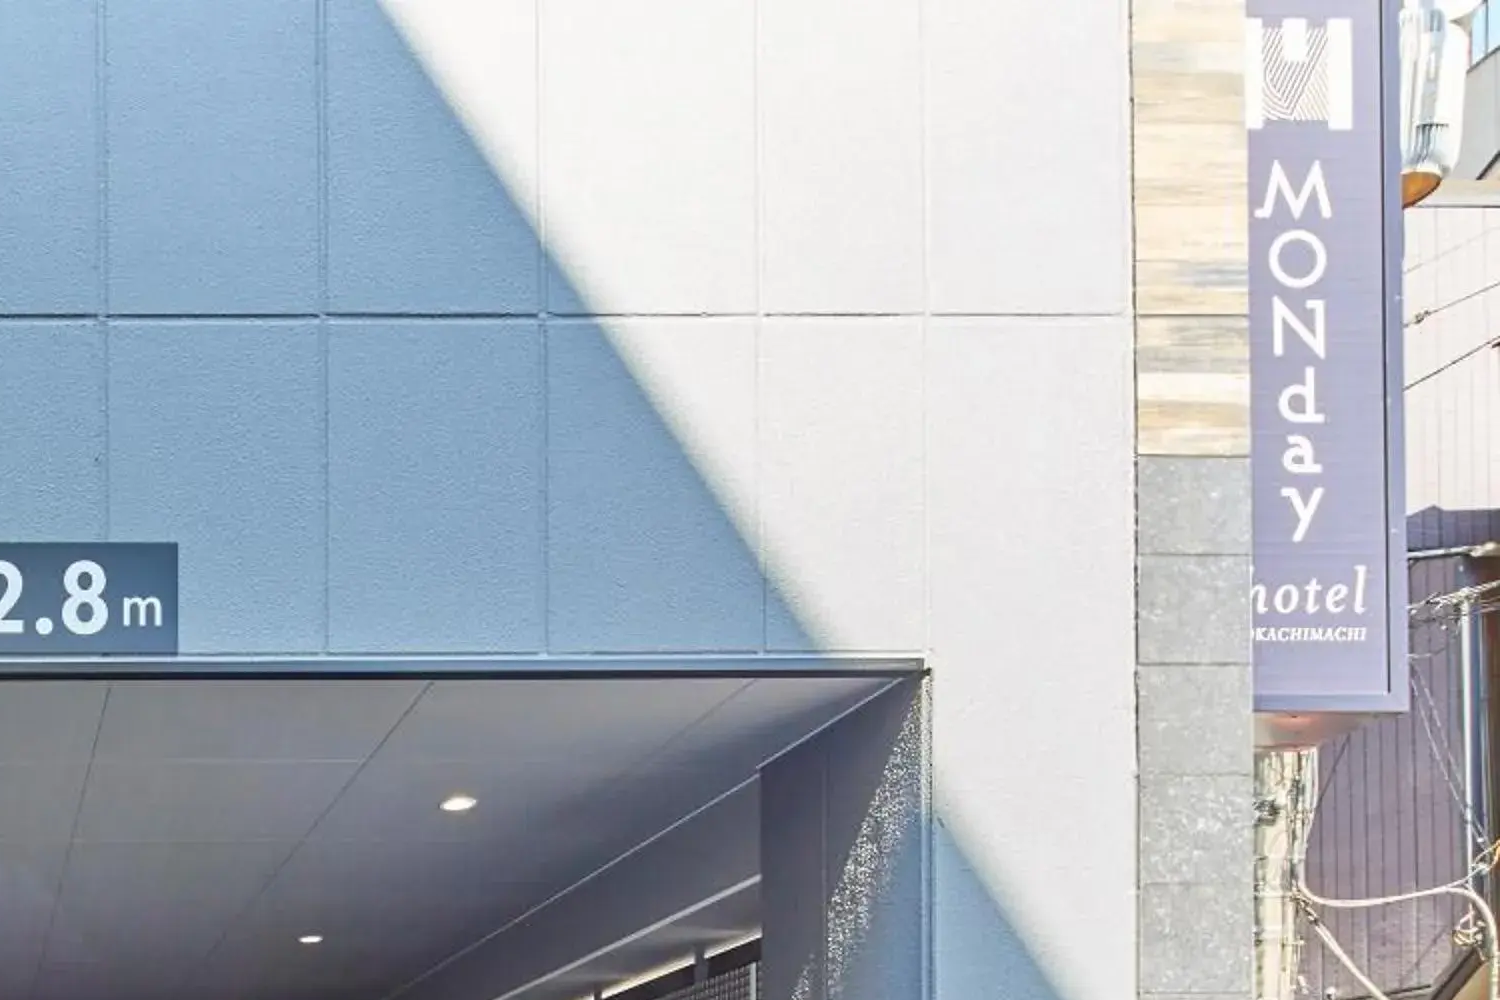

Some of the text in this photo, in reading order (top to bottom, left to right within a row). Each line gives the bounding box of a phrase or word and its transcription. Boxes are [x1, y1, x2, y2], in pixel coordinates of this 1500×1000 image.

[1254, 159, 1332, 543] MONday
[123, 595, 163, 627] m
[1251, 627, 1367, 641] KACHIMACHI
